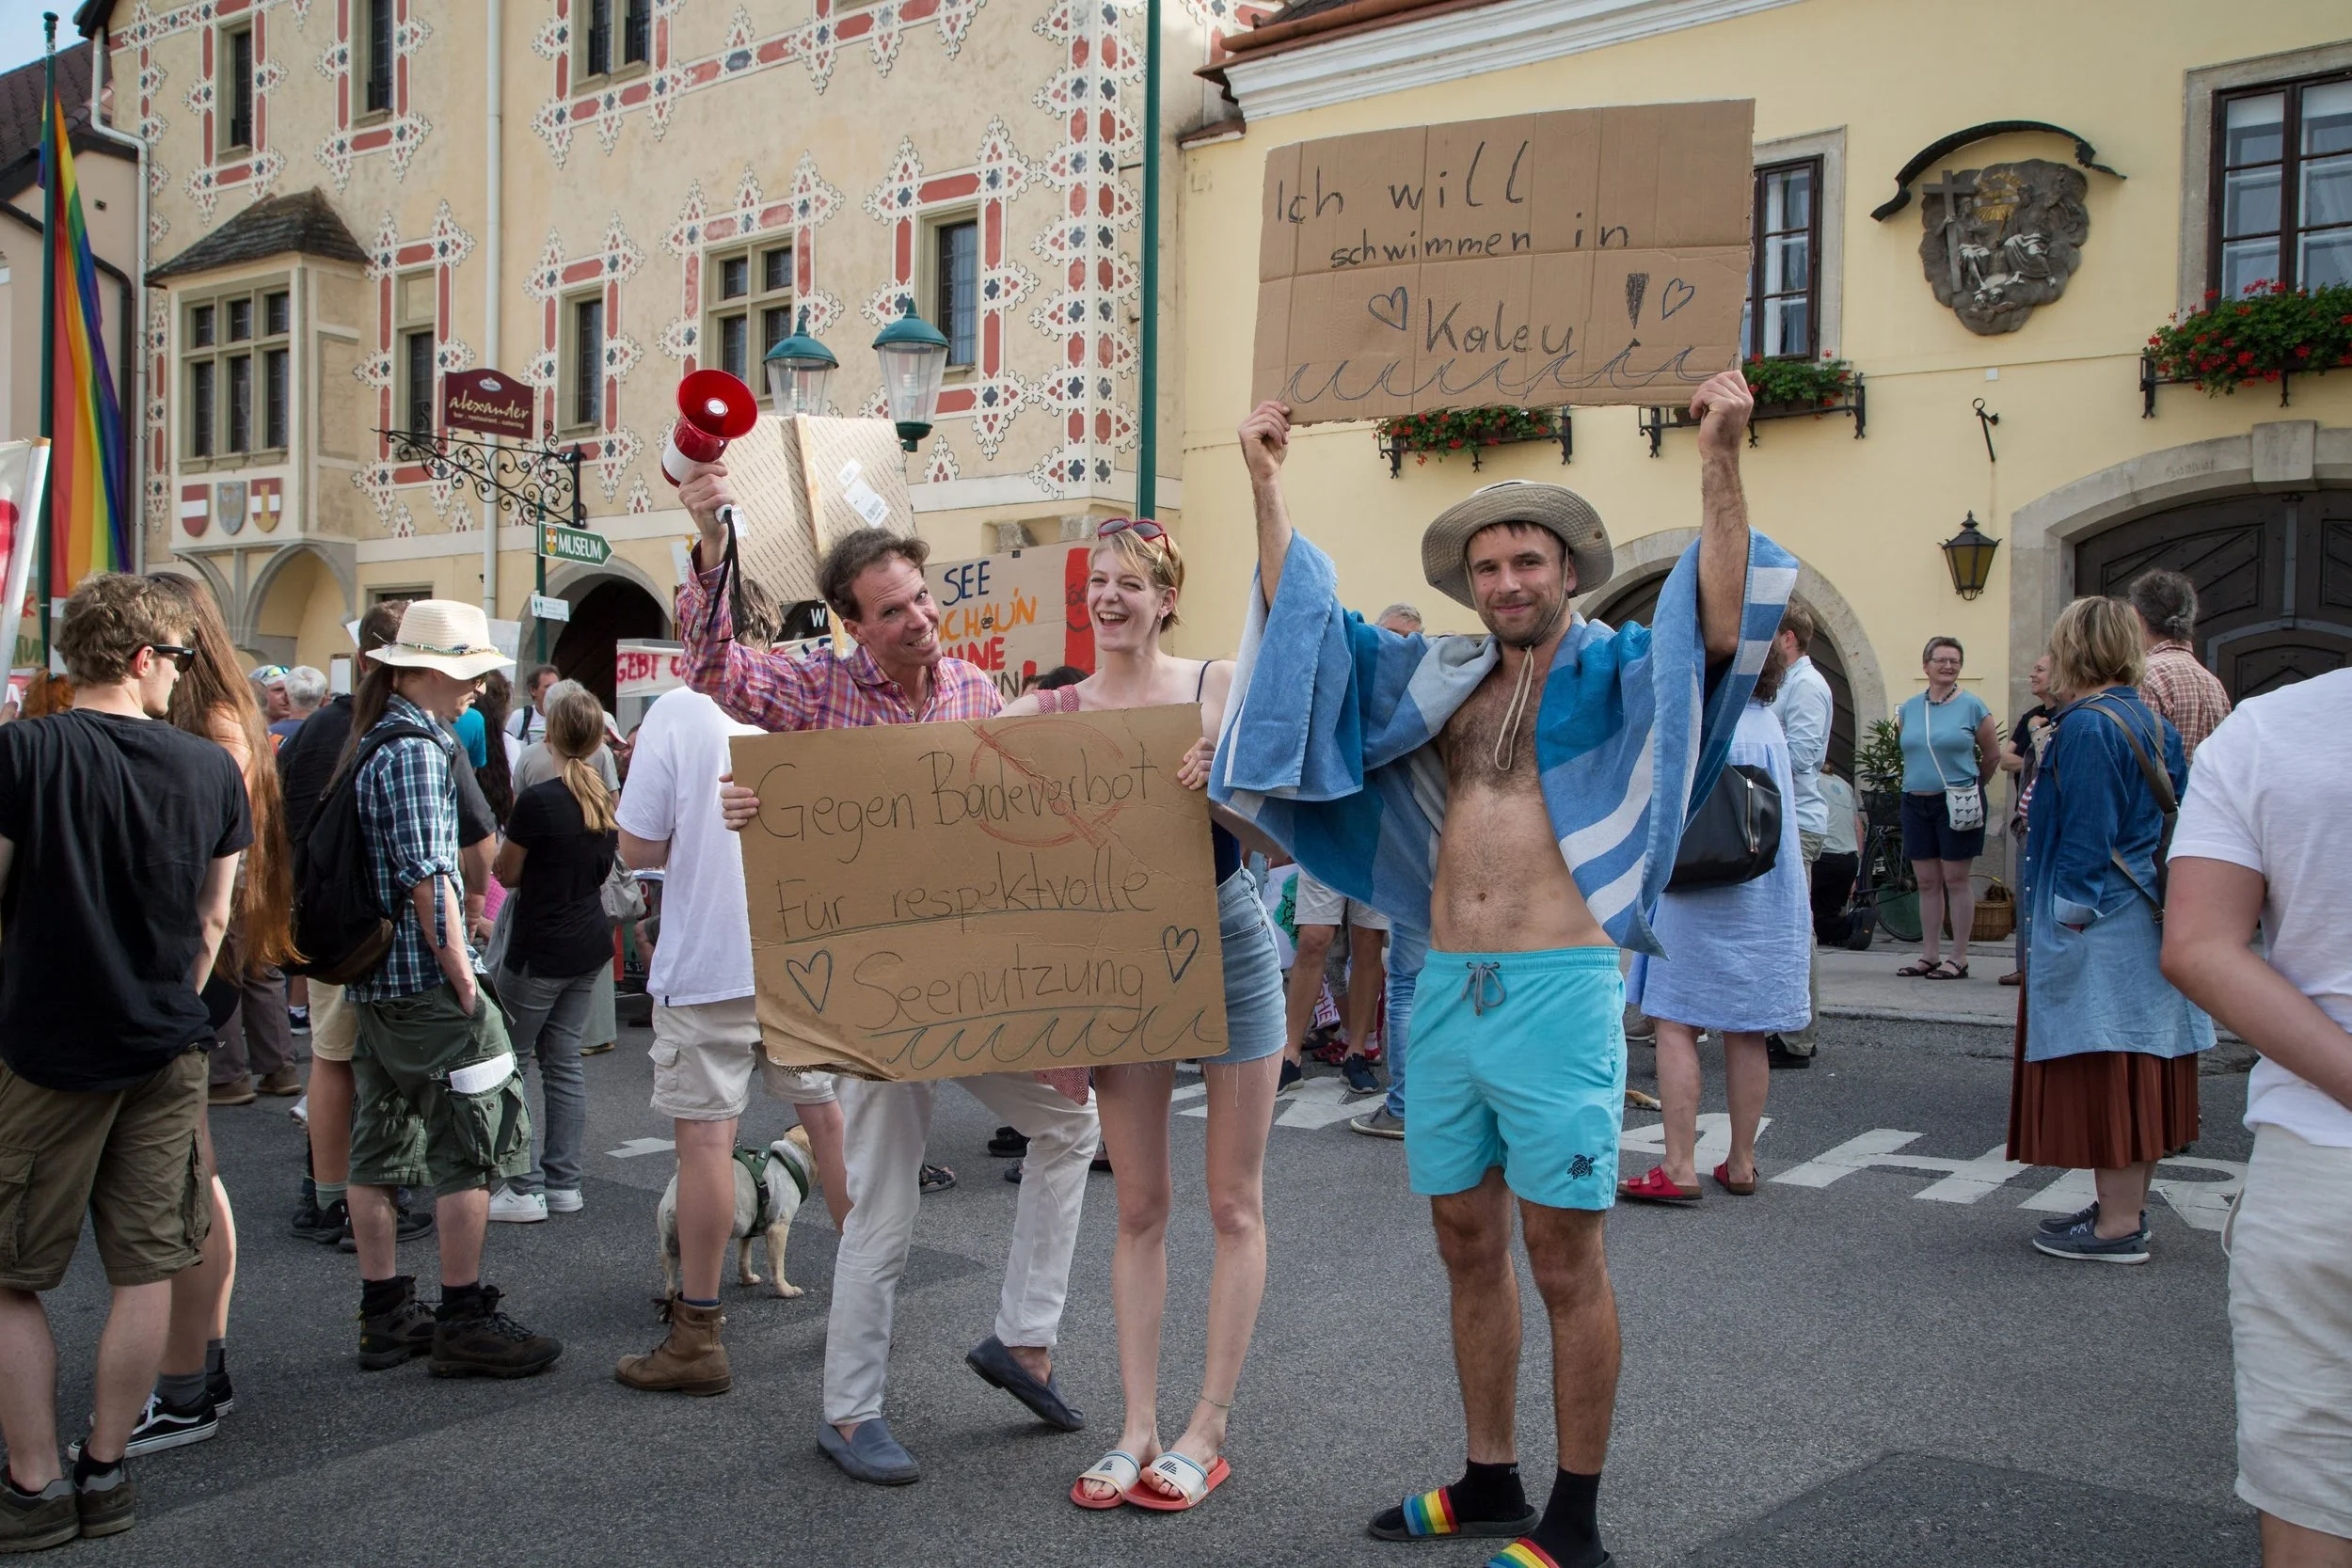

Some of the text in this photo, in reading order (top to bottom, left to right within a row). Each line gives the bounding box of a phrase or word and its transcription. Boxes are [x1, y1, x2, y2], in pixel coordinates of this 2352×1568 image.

[1276, 140, 1530, 224] Ich will
[1330, 212, 1629, 269] schwimmen in
[448, 388, 529, 419] alexander
[558, 532, 602, 560] MUSEUM
[942, 561, 991, 607] SEE
[939, 587, 1037, 643] CHAU'N
[756, 741, 1159, 863] Gegen Badeverbot
[775, 846, 1156, 938] Für respektvolle
[853, 943, 1145, 1033] Seenutzung
